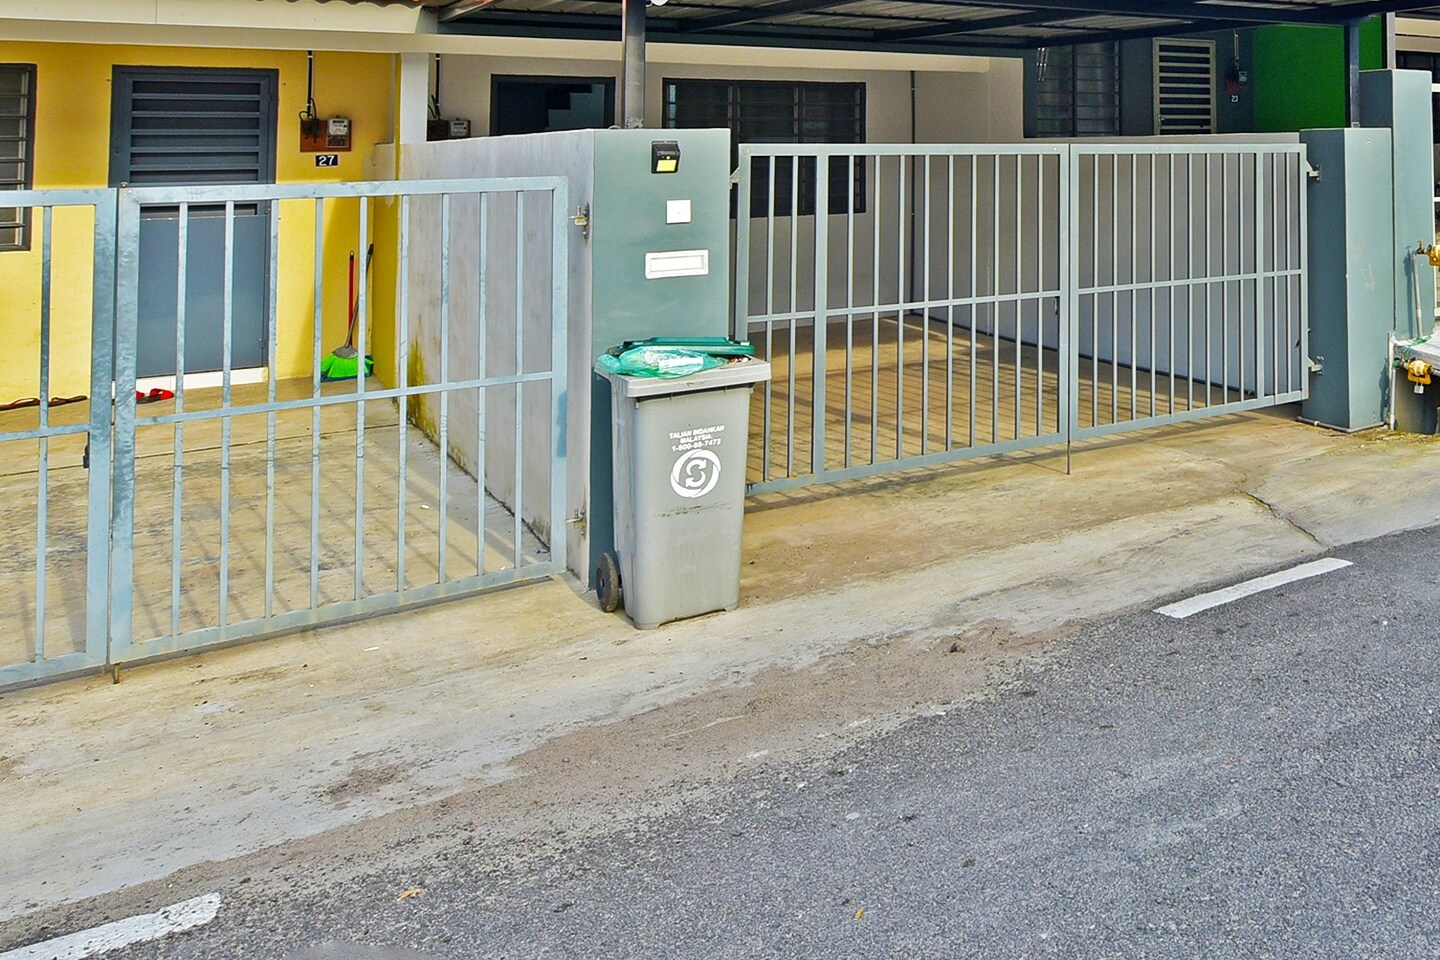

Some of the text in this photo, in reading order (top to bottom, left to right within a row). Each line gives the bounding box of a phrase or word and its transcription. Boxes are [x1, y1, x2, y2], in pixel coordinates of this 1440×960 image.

[318, 155, 335, 166] 27
[669, 430, 692, 439] TALIAN
[680, 433, 712, 444] MALAYSIA
